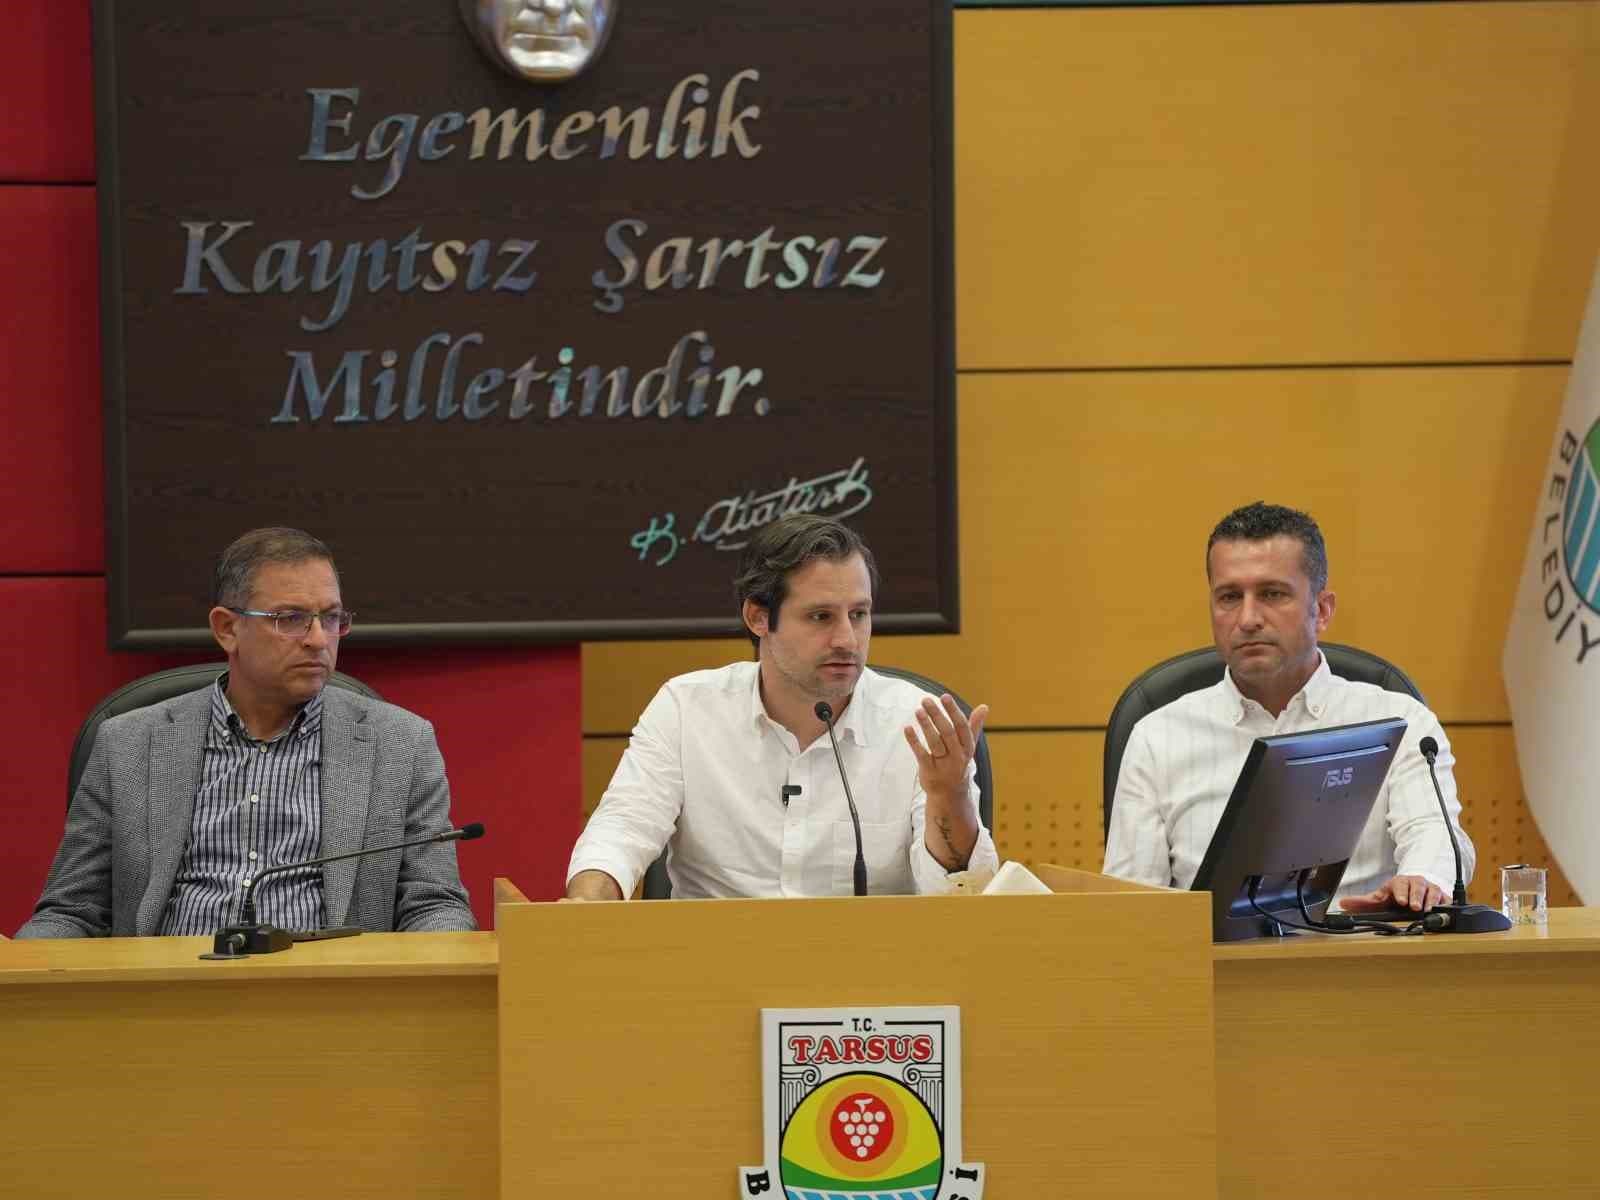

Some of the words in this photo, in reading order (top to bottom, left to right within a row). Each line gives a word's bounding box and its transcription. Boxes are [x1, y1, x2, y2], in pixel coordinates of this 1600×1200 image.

[298, 69, 762, 199] Egemenlik
[174, 219, 540, 331] Kayıtsız
[591, 217, 888, 314] Şartsız
[270, 330, 771, 424] Milletindir.
[1321, 766, 1354, 788] ASUS
[788, 1034, 934, 1064] TARSUS
[852, 1018, 877, 1032] T.C.
